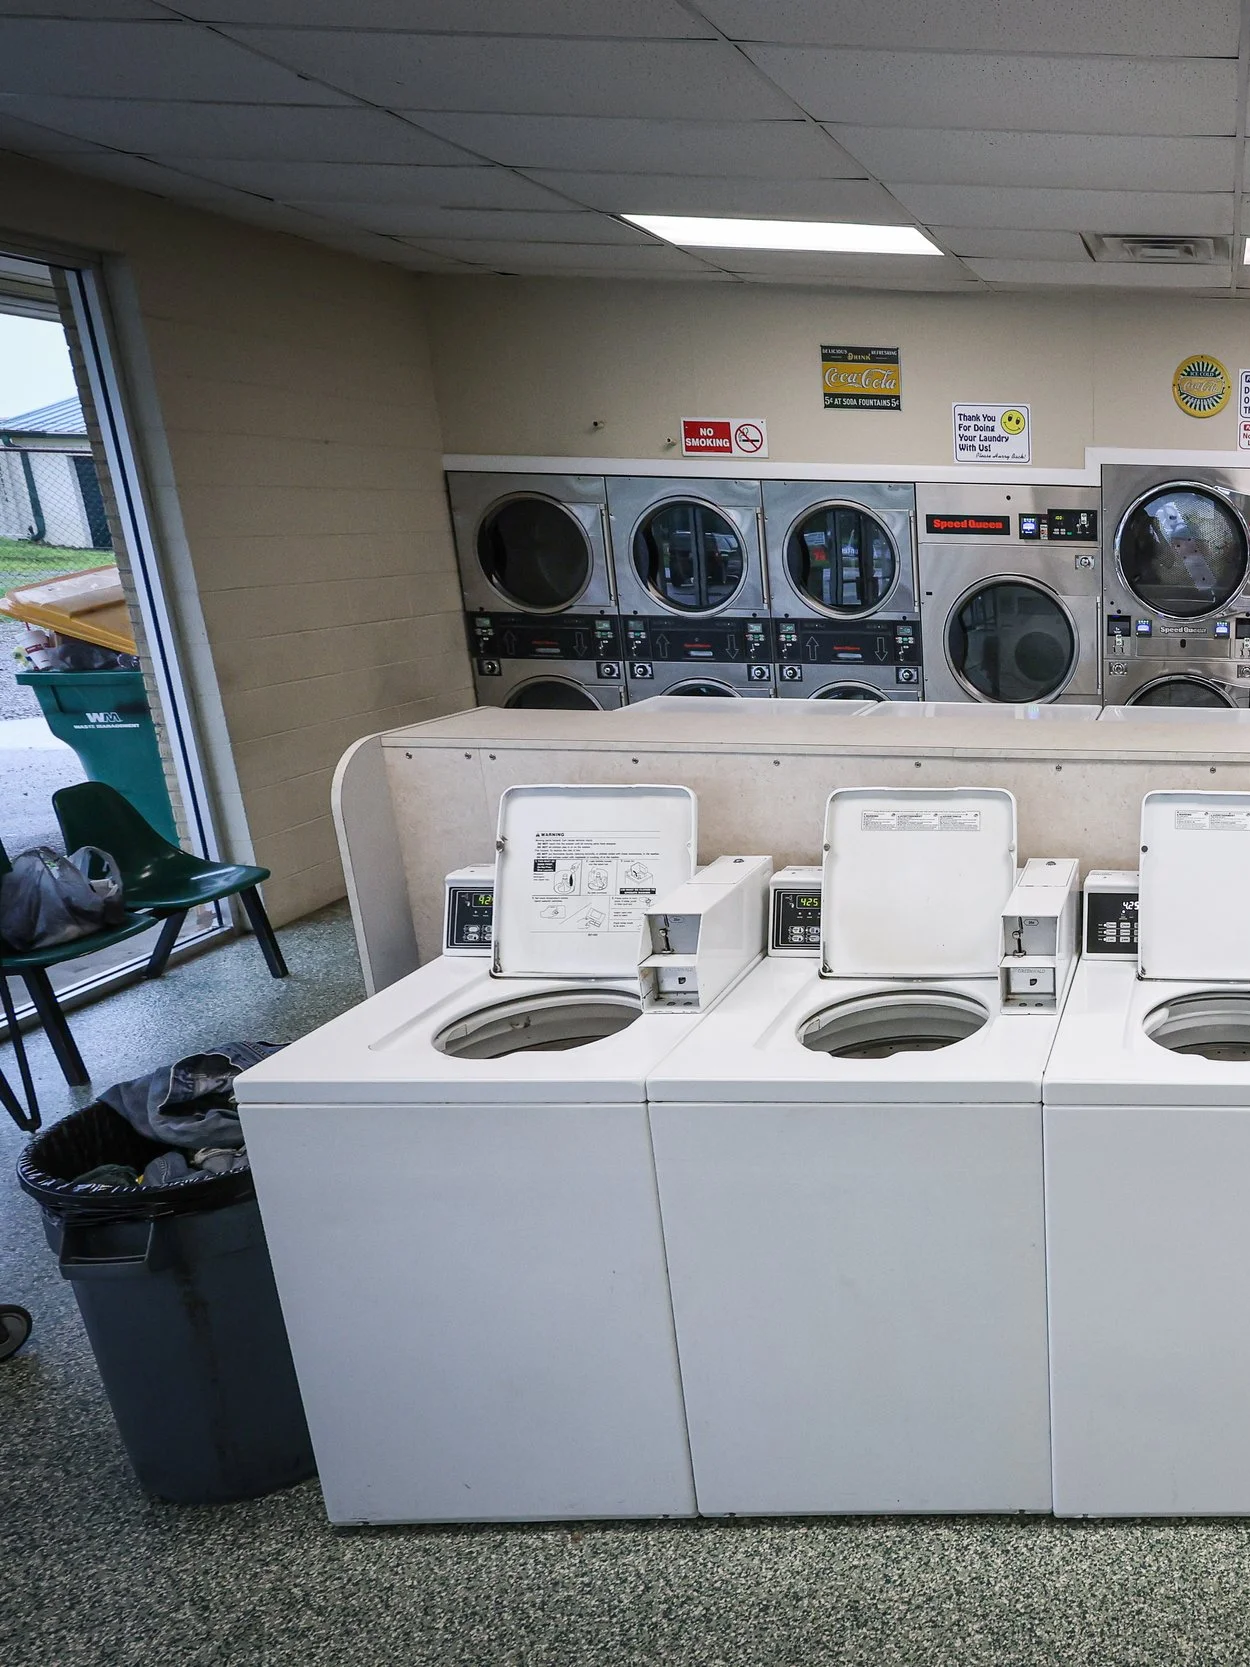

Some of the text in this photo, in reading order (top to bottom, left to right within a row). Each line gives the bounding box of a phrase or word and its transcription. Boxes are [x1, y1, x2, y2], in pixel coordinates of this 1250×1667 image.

[842, 398, 857, 406] SODA
[859, 399, 890, 407] FOUNTAINS
[958, 413, 996, 422] Thank You
[700, 427, 714, 436] NO
[973, 424, 995, 432] Doing
[685, 438, 730, 447] SMOKING
[979, 434, 1009, 442] Laundry
[978, 444, 991, 452] Us!
[933, 519, 1003, 529] Speed Queen
